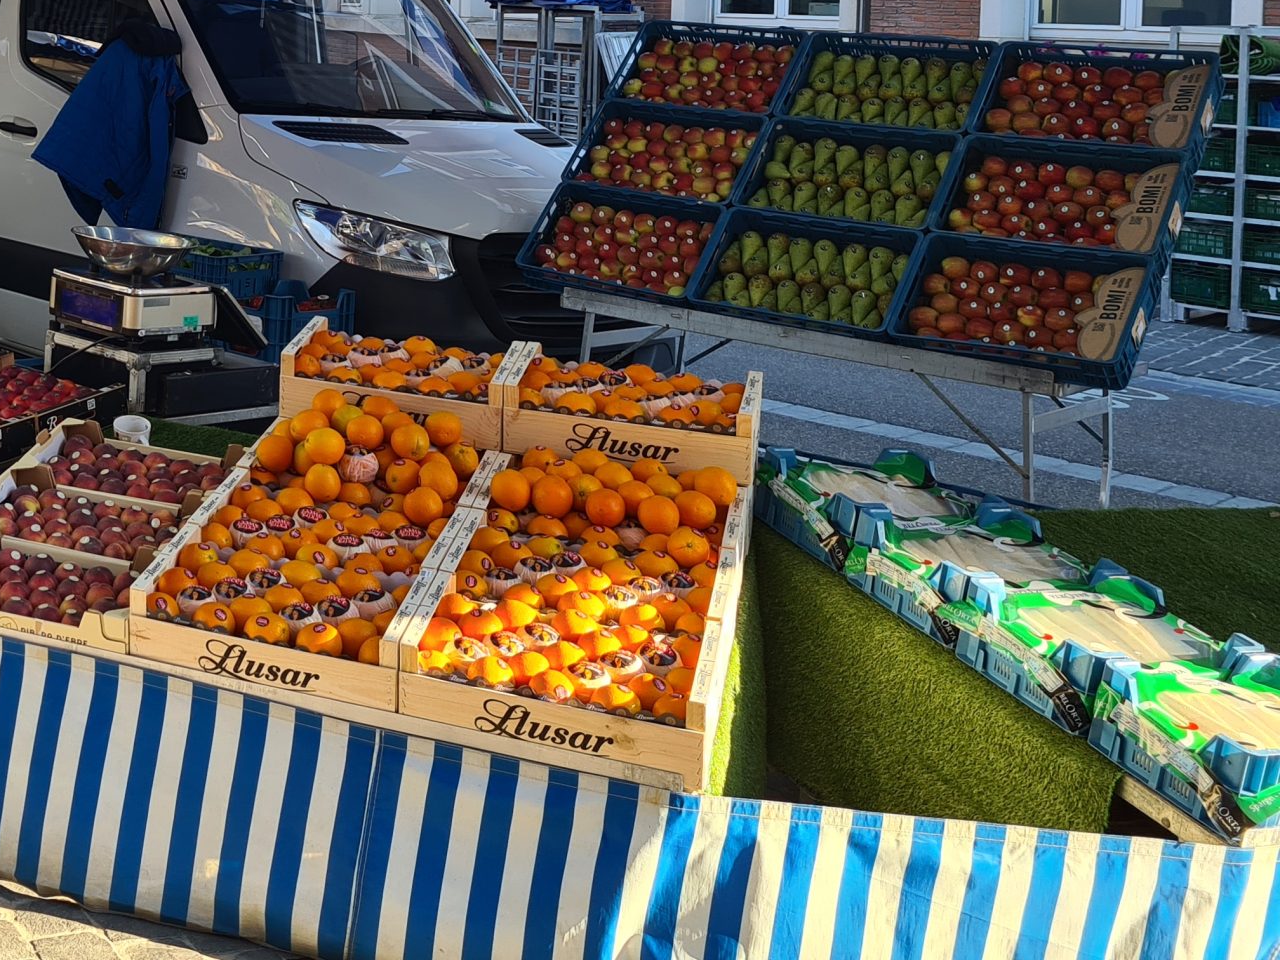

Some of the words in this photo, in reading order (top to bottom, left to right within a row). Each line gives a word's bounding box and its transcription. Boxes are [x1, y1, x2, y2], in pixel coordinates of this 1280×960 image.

[1172, 84, 1198, 112] BOMI
[1135, 185, 1163, 214] BOMI
[1099, 290, 1127, 320] BOMI
